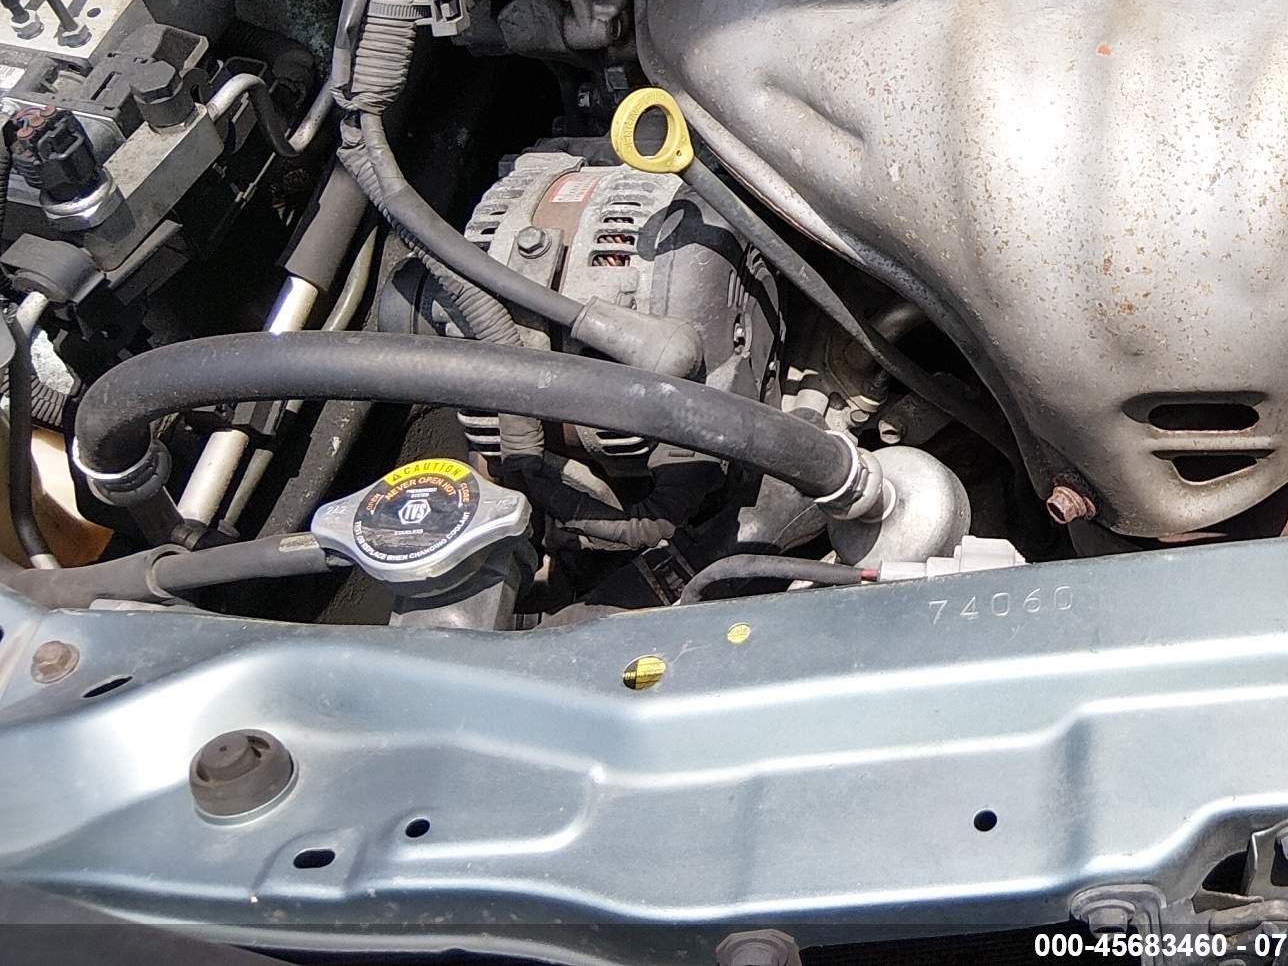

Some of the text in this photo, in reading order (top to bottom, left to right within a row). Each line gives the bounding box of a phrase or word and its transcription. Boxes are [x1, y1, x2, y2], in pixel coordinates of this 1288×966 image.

[403, 462, 461, 476] CAUTION
[385, 476, 457, 500] NEVER OPEN HOT
[402, 504, 427, 521] TVS
[409, 538, 448, 559] CHANGING
[446, 512, 471, 540] COOLANT
[928, 585, 1074, 625] 74060
